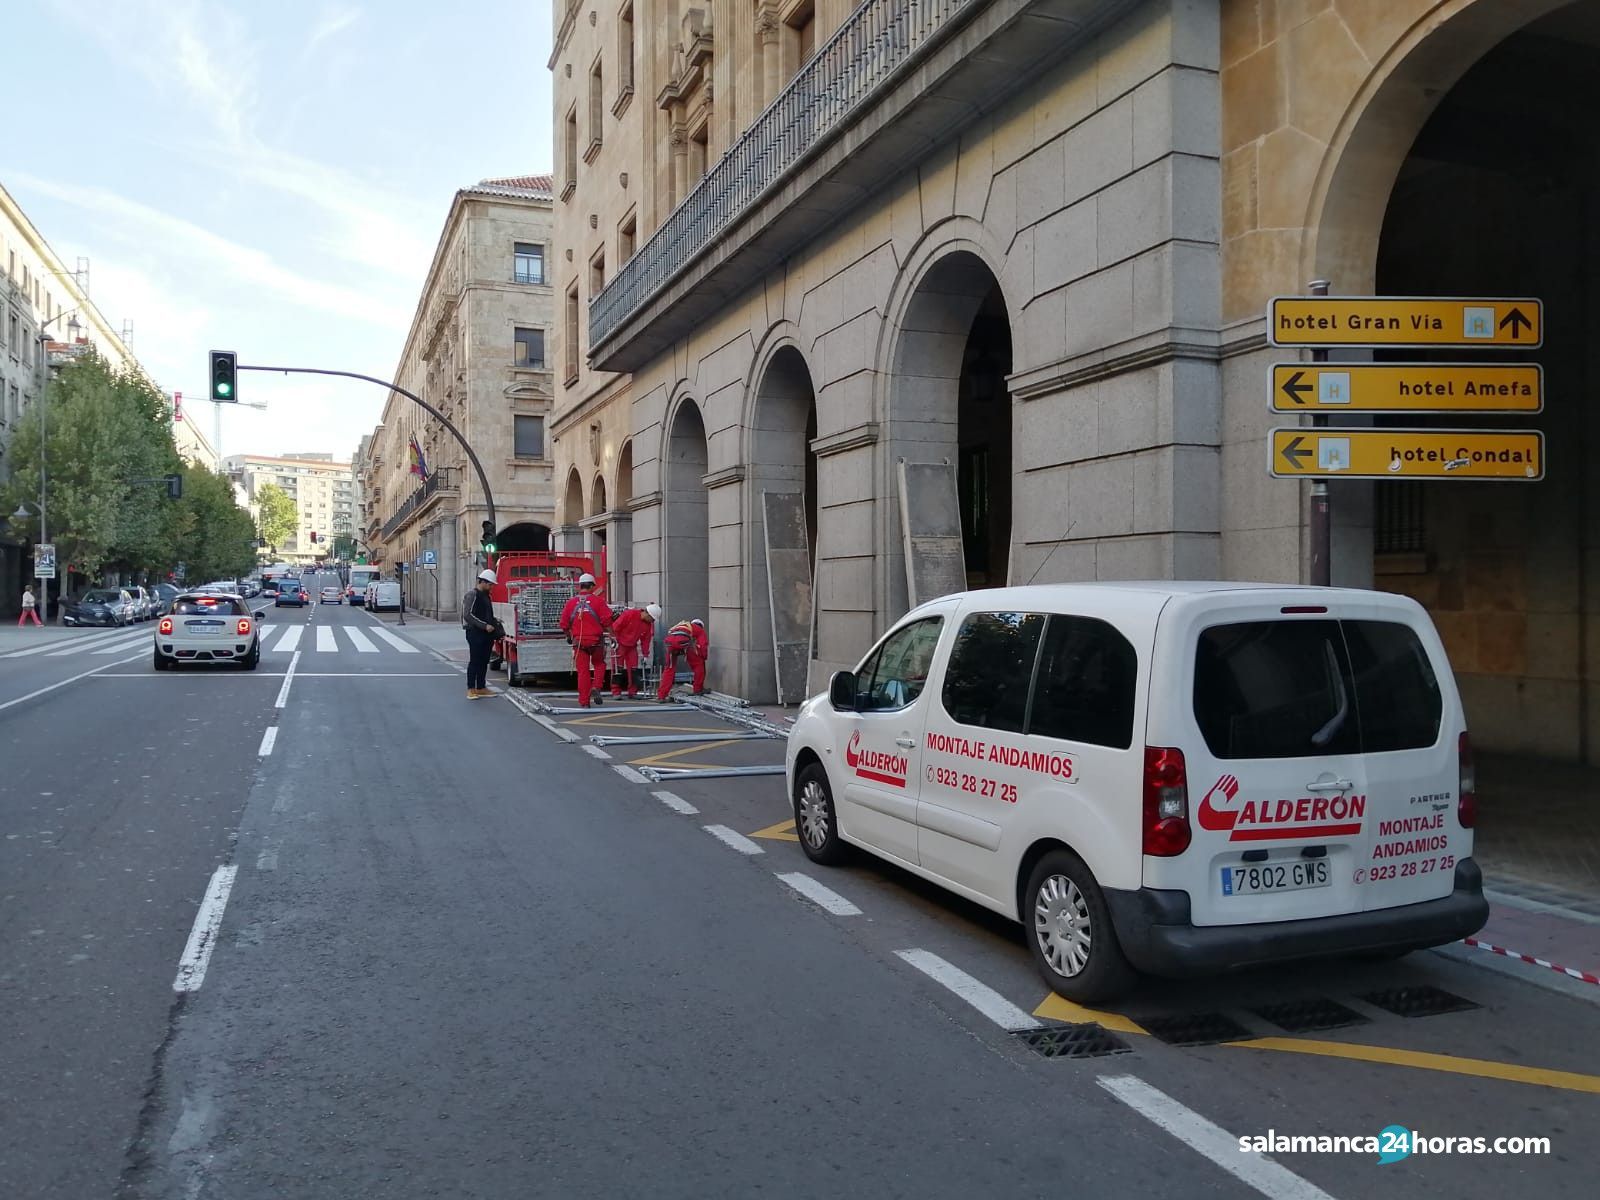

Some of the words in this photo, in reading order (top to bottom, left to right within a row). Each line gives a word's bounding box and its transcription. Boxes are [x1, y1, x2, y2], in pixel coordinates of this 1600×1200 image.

[1280, 315, 1337, 329] hotel
[1348, 315, 1400, 329] Gran
[1400, 381, 1454, 396] hotel
[1464, 381, 1532, 396] Amefa
[1391, 447, 1446, 462] hotel
[1456, 448, 1532, 463] Condal
[927, 732, 985, 760] MONTAJE
[988, 744, 1073, 778] ANDAMIOS
[937, 767, 958, 787] 923
[962, 774, 977, 793] 28
[981, 779, 996, 798] 27
[1001, 783, 1017, 803] 25
[1379, 814, 1444, 836] MONTAJE
[1372, 835, 1448, 859] ANDAMIOS
[1235, 866, 1287, 891] 7802
[1292, 862, 1327, 886] GWS
[1370, 865, 1396, 881] 923
[1401, 862, 1417, 877] 28
[1421, 858, 1436, 874] 27
[1440, 855, 1455, 870] 25
